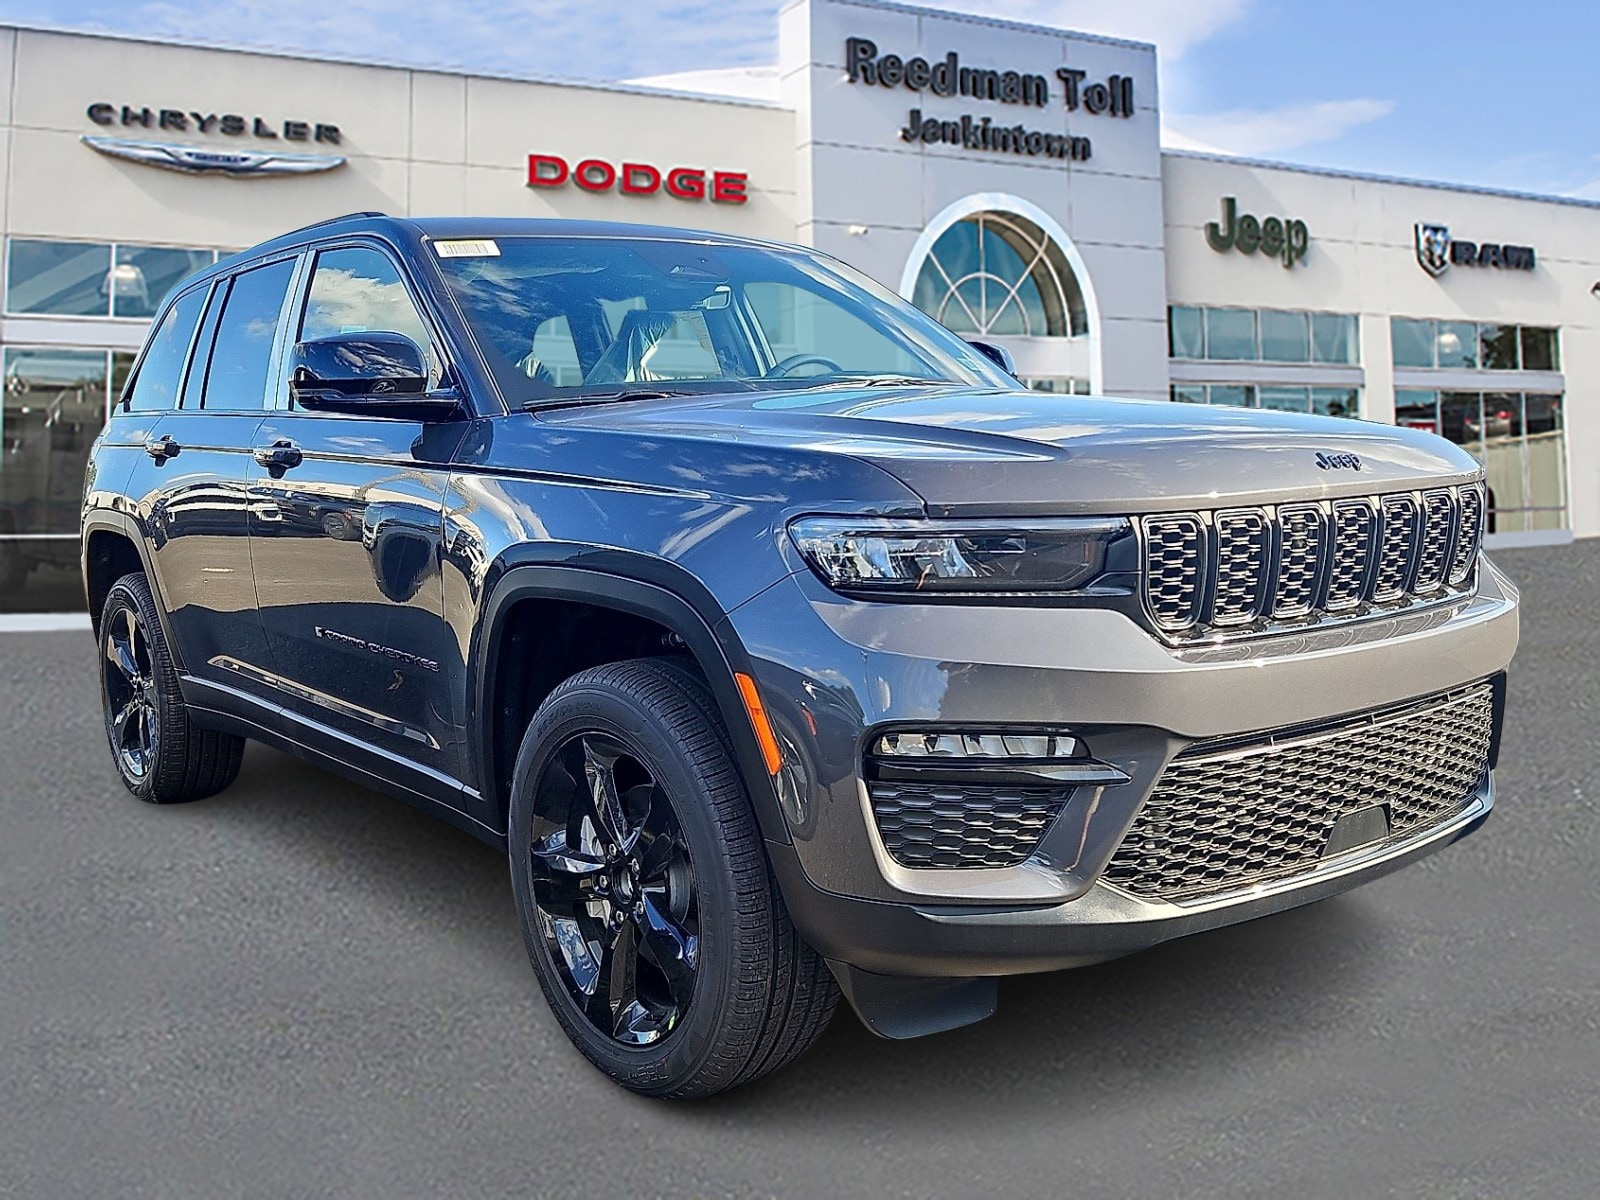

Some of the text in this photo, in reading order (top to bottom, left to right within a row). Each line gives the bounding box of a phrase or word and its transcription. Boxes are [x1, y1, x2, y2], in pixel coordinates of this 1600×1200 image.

[845, 37, 1134, 118] Reedman Toll
[87, 102, 341, 145] CHRYSLER
[901, 109, 1091, 161] Jenkintown
[527, 154, 748, 205] DODGE
[1205, 197, 1308, 269] Jeep
[1450, 240, 1536, 271] RAM
[1315, 452, 1362, 471] Jeep
